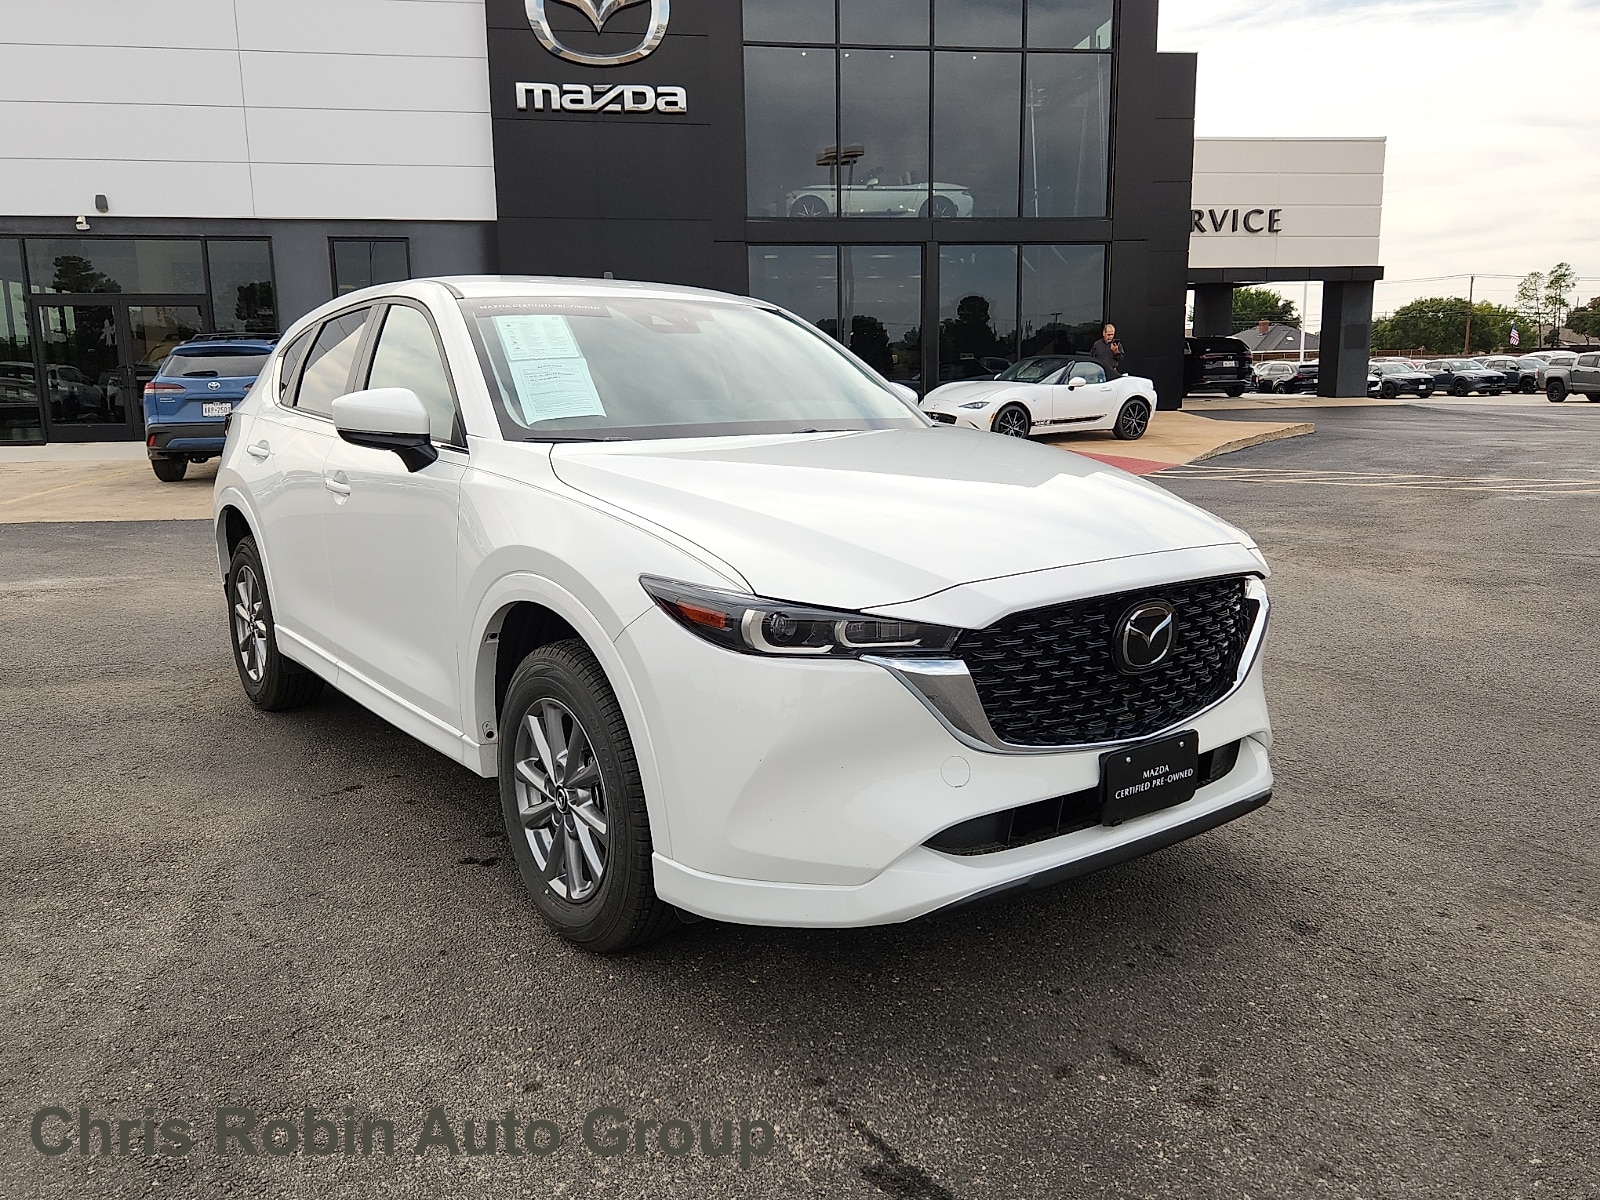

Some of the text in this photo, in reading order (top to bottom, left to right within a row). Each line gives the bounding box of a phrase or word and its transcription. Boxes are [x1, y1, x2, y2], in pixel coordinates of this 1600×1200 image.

[1142, 764, 1169, 779] MAZDA
[1115, 768, 1194, 799] CERTIFIED PRE-OWNED
